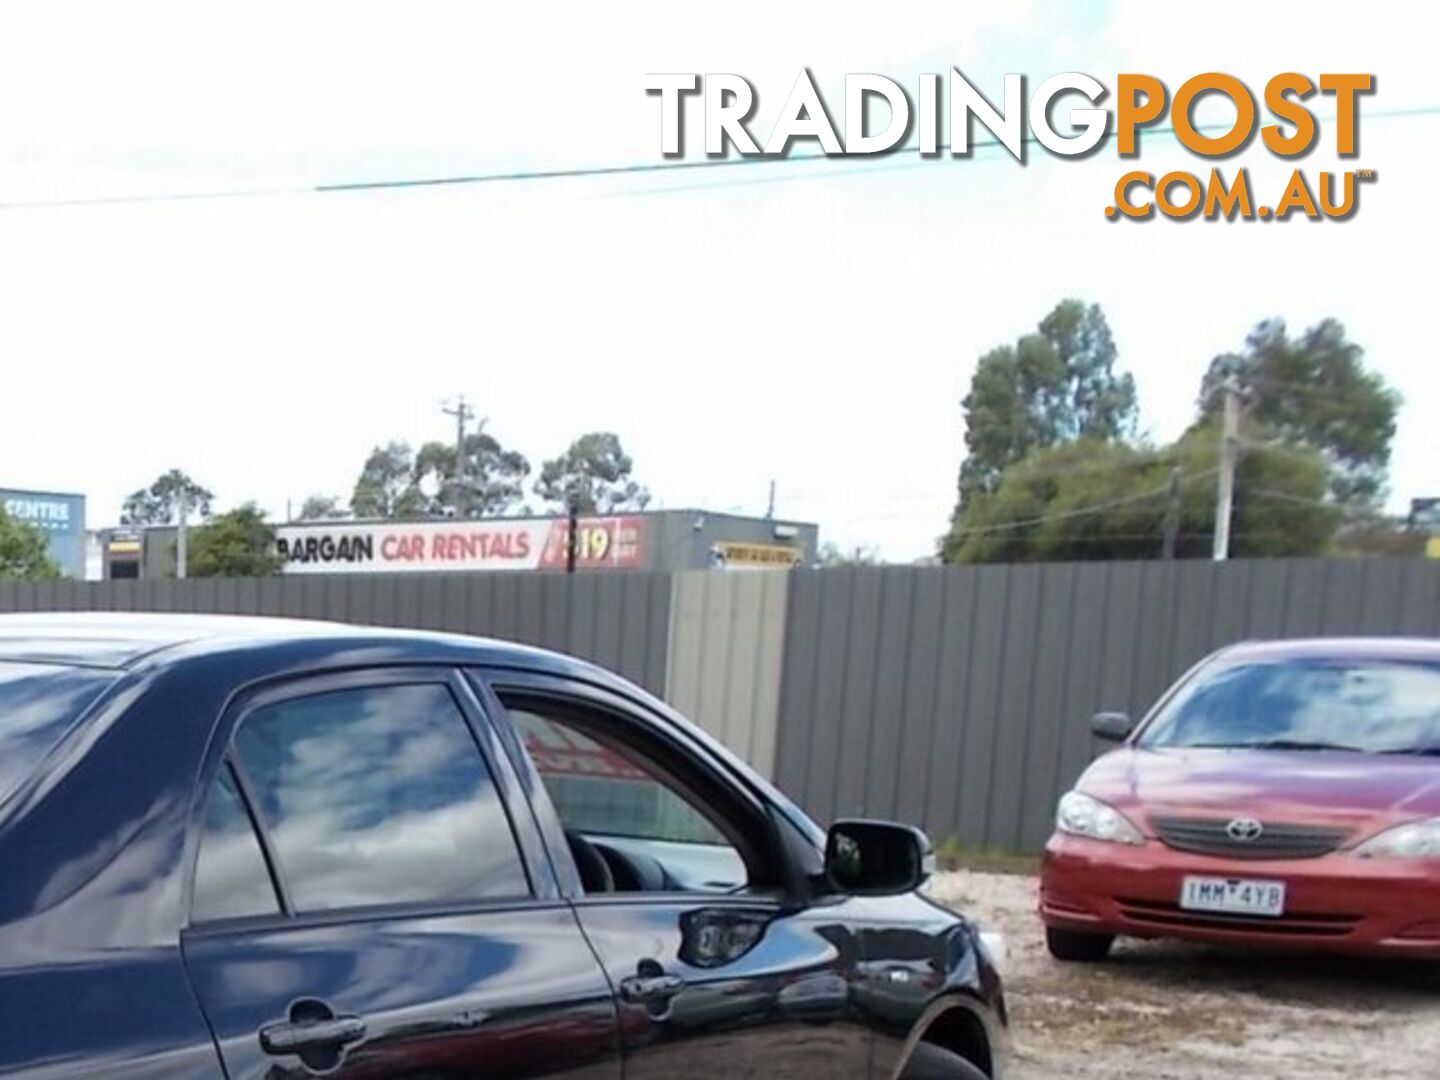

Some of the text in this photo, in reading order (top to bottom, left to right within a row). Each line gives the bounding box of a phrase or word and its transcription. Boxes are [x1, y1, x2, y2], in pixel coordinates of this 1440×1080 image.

[4, 499, 69, 521] CENTRE
[277, 535, 373, 563] BARGAIN
[381, 535, 424, 561] CAR
[432, 532, 529, 559] RENTALS
